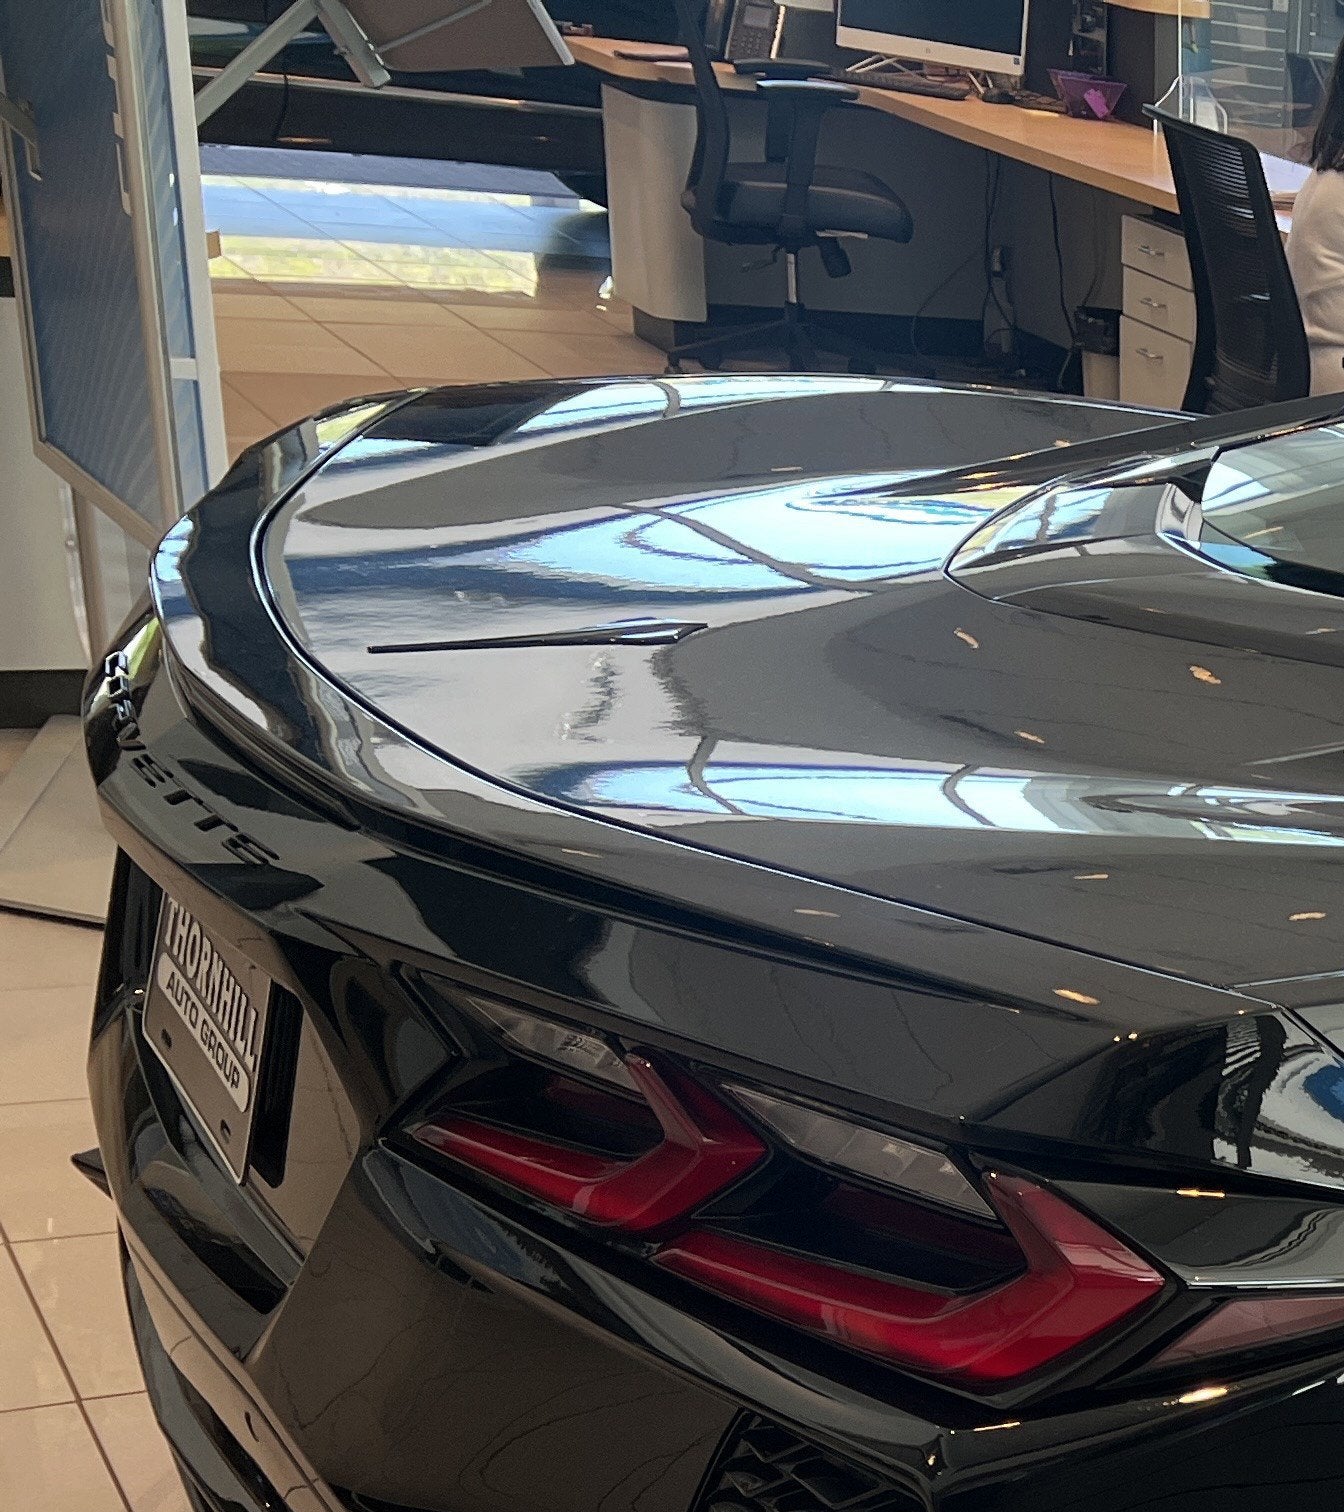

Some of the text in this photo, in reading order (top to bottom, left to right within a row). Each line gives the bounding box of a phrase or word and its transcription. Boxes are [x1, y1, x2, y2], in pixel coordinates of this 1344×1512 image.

[165, 897, 259, 1073] THORNHILL
[165, 971, 241, 1089] AUTO GROUP
